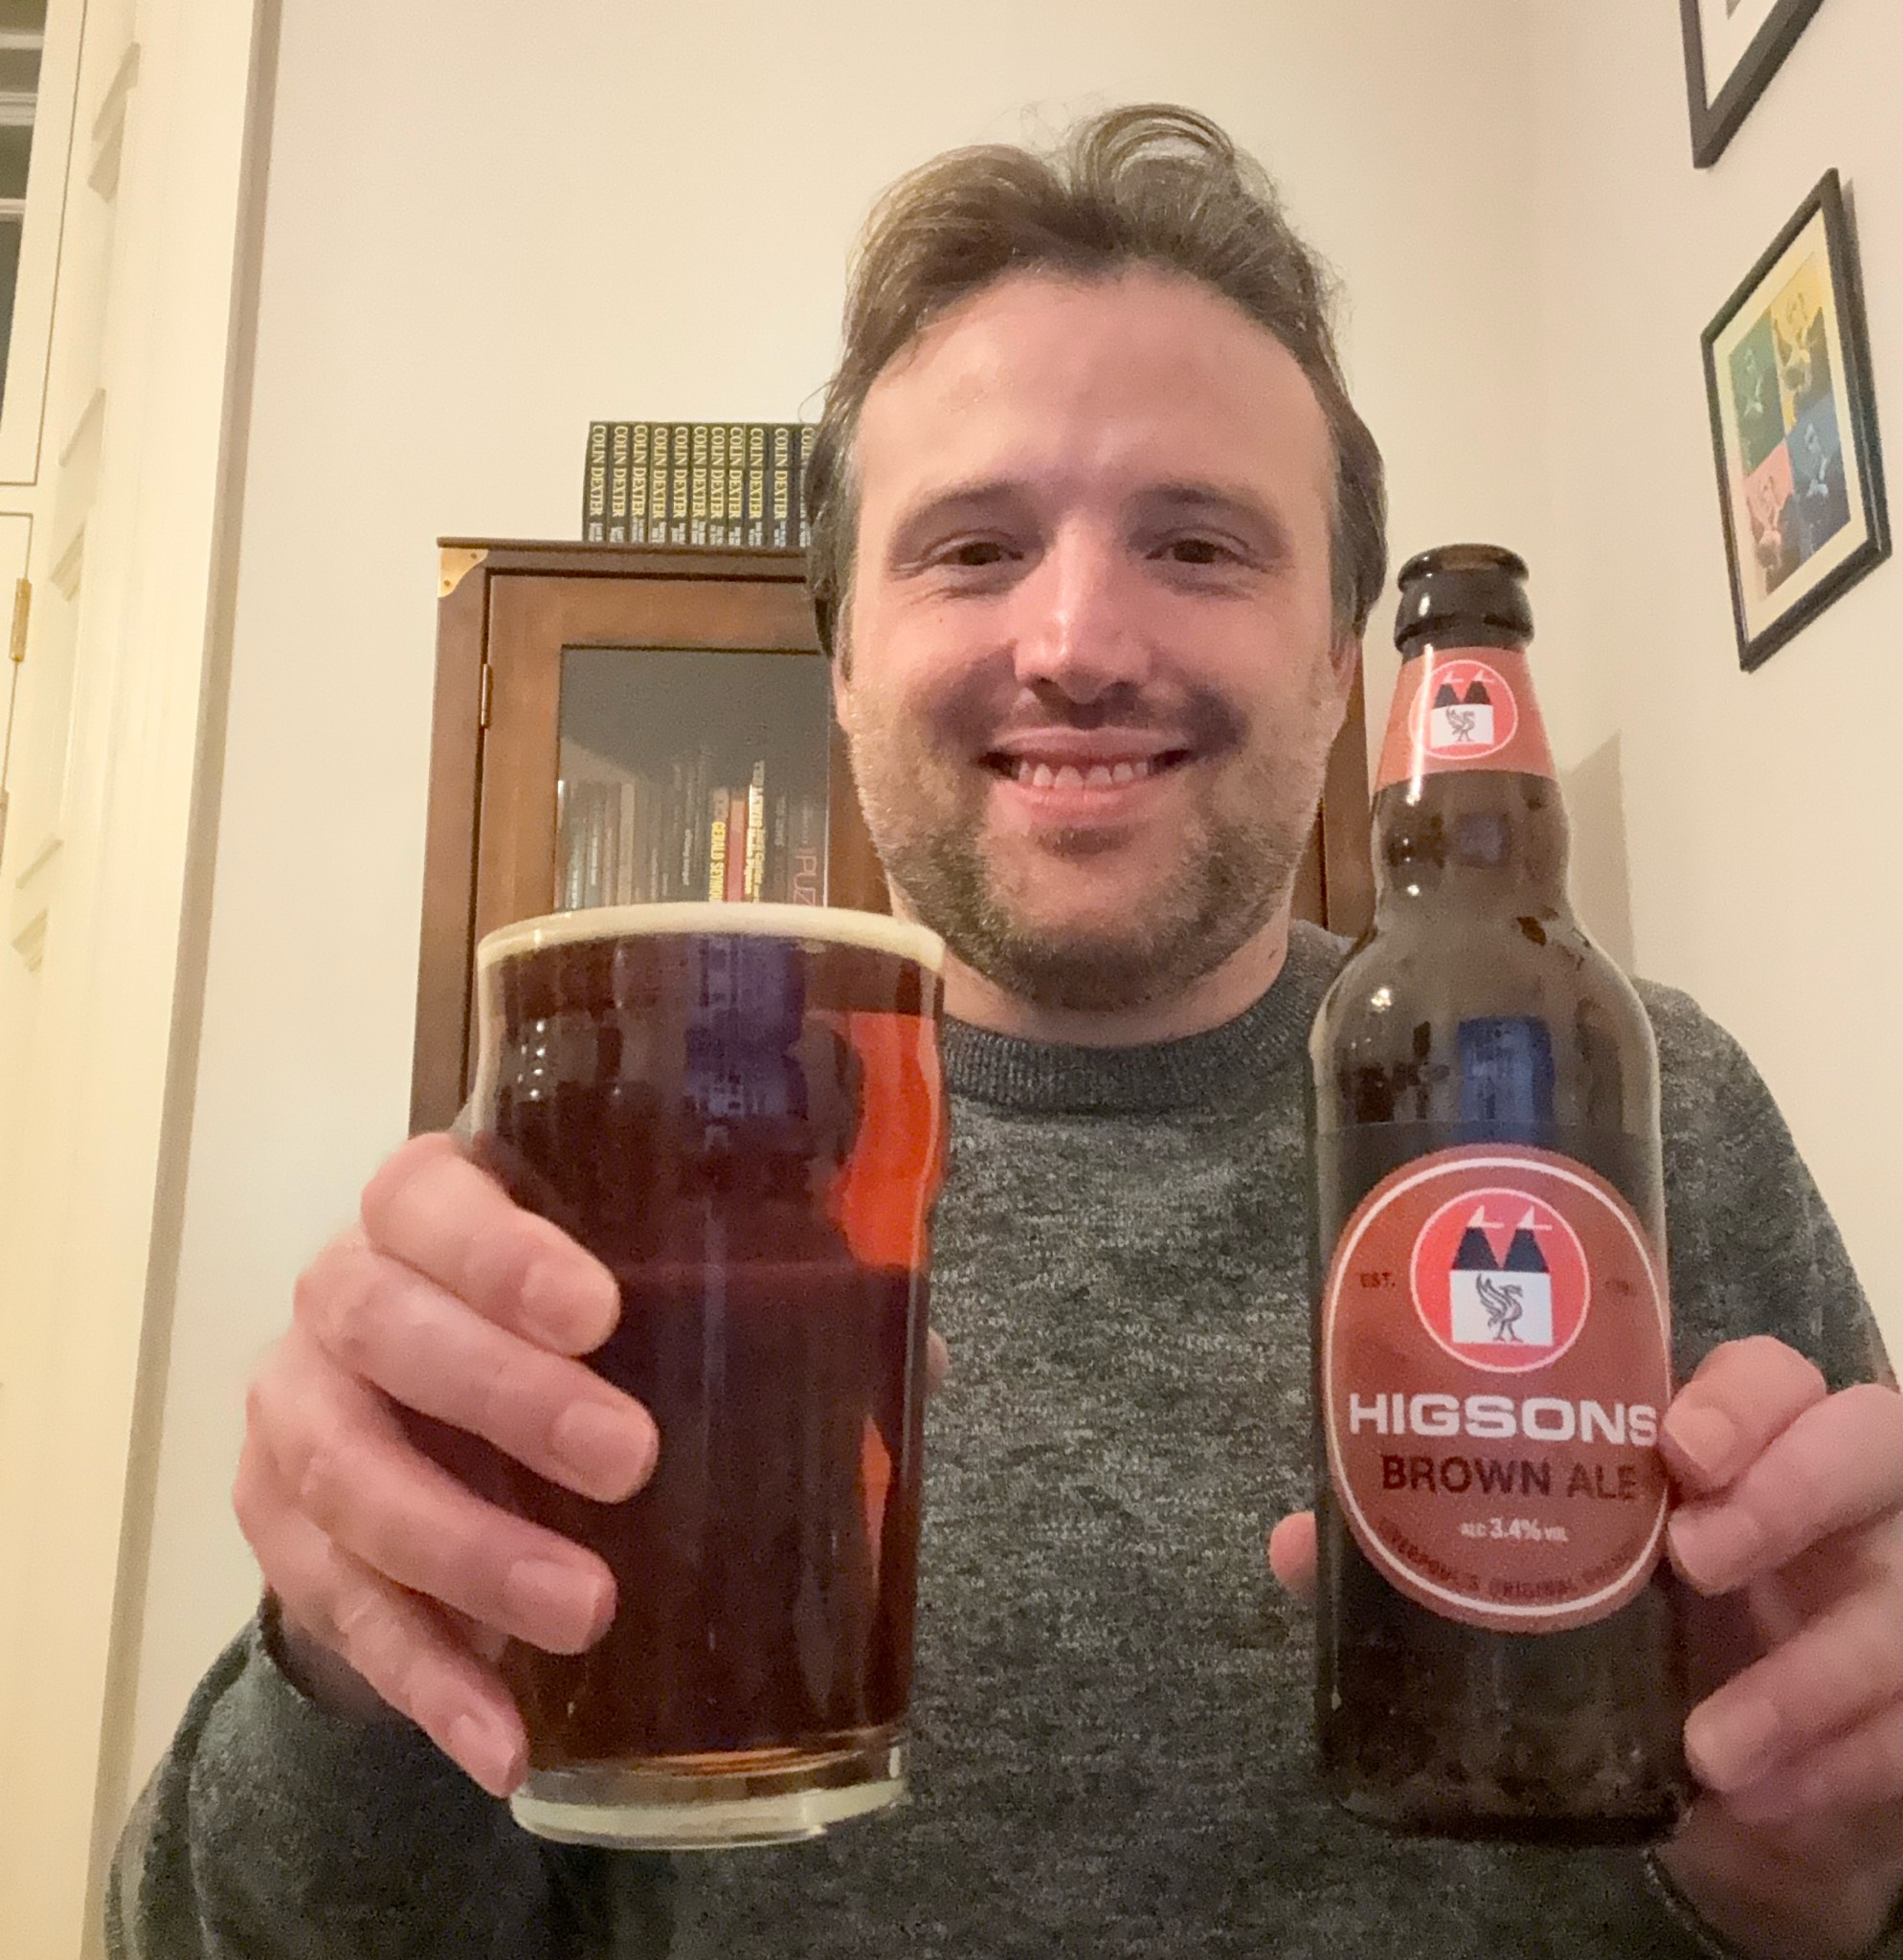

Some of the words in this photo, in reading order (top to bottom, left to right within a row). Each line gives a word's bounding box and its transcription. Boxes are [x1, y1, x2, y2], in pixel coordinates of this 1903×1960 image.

[592, 425, 607, 464] COLIN
[614, 426, 628, 464] COLIN
[634, 425, 648, 464] COLIN
[654, 427, 668, 465] COLIN
[674, 426, 688, 465] COLIN
[694, 426, 707, 465] COLIN
[711, 427, 725, 466] COLIN
[729, 427, 743, 466] COLIN
[750, 428, 764, 467] COLIN
[774, 428, 789, 467] COLIN
[590, 467, 606, 516] DEXTER
[612, 468, 627, 518] DEXTER
[632, 467, 646, 517] DEXTER
[652, 470, 666, 519] DEXTER
[672, 469, 687, 519] DEXTER
[692, 468, 706, 518] DEXTER
[710, 469, 725, 518] DEXTER
[728, 469, 743, 519] DEXTER
[749, 470, 763, 519] DEXTER
[773, 470, 788, 520] DEXTER
[710, 821, 726, 860] GERALD
[1349, 1393, 1659, 1447] HIGSONS
[1381, 1455, 1551, 1499] BROWN
[1566, 1463, 1638, 1501] ALE
[1489, 1517, 1541, 1541] 3.4%
